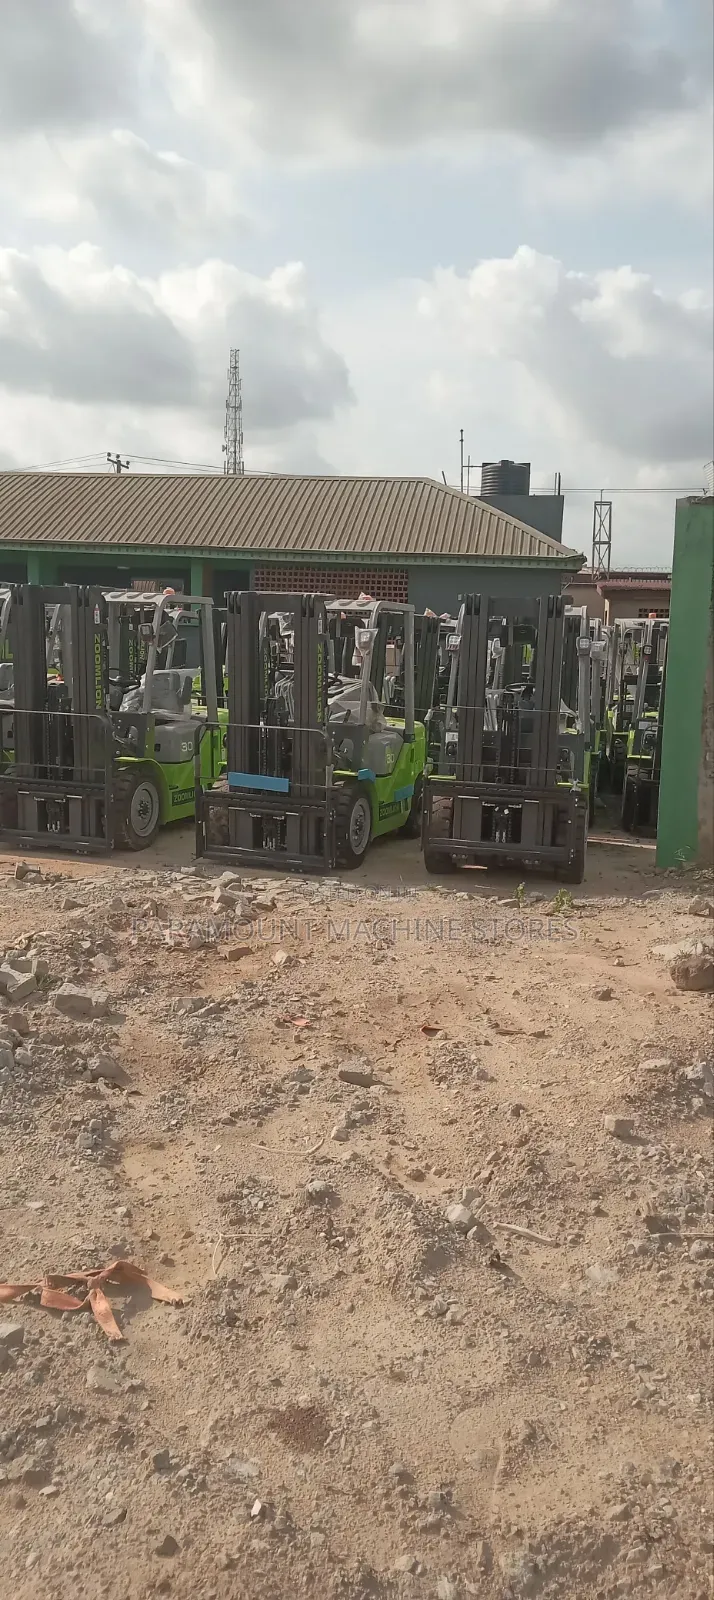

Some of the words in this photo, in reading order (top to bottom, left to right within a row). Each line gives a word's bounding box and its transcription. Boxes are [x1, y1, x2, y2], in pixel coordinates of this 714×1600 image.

[94, 633, 102, 710] ZOOMLION
[181, 741, 193, 752] 30
[386, 753, 394, 763] 30
